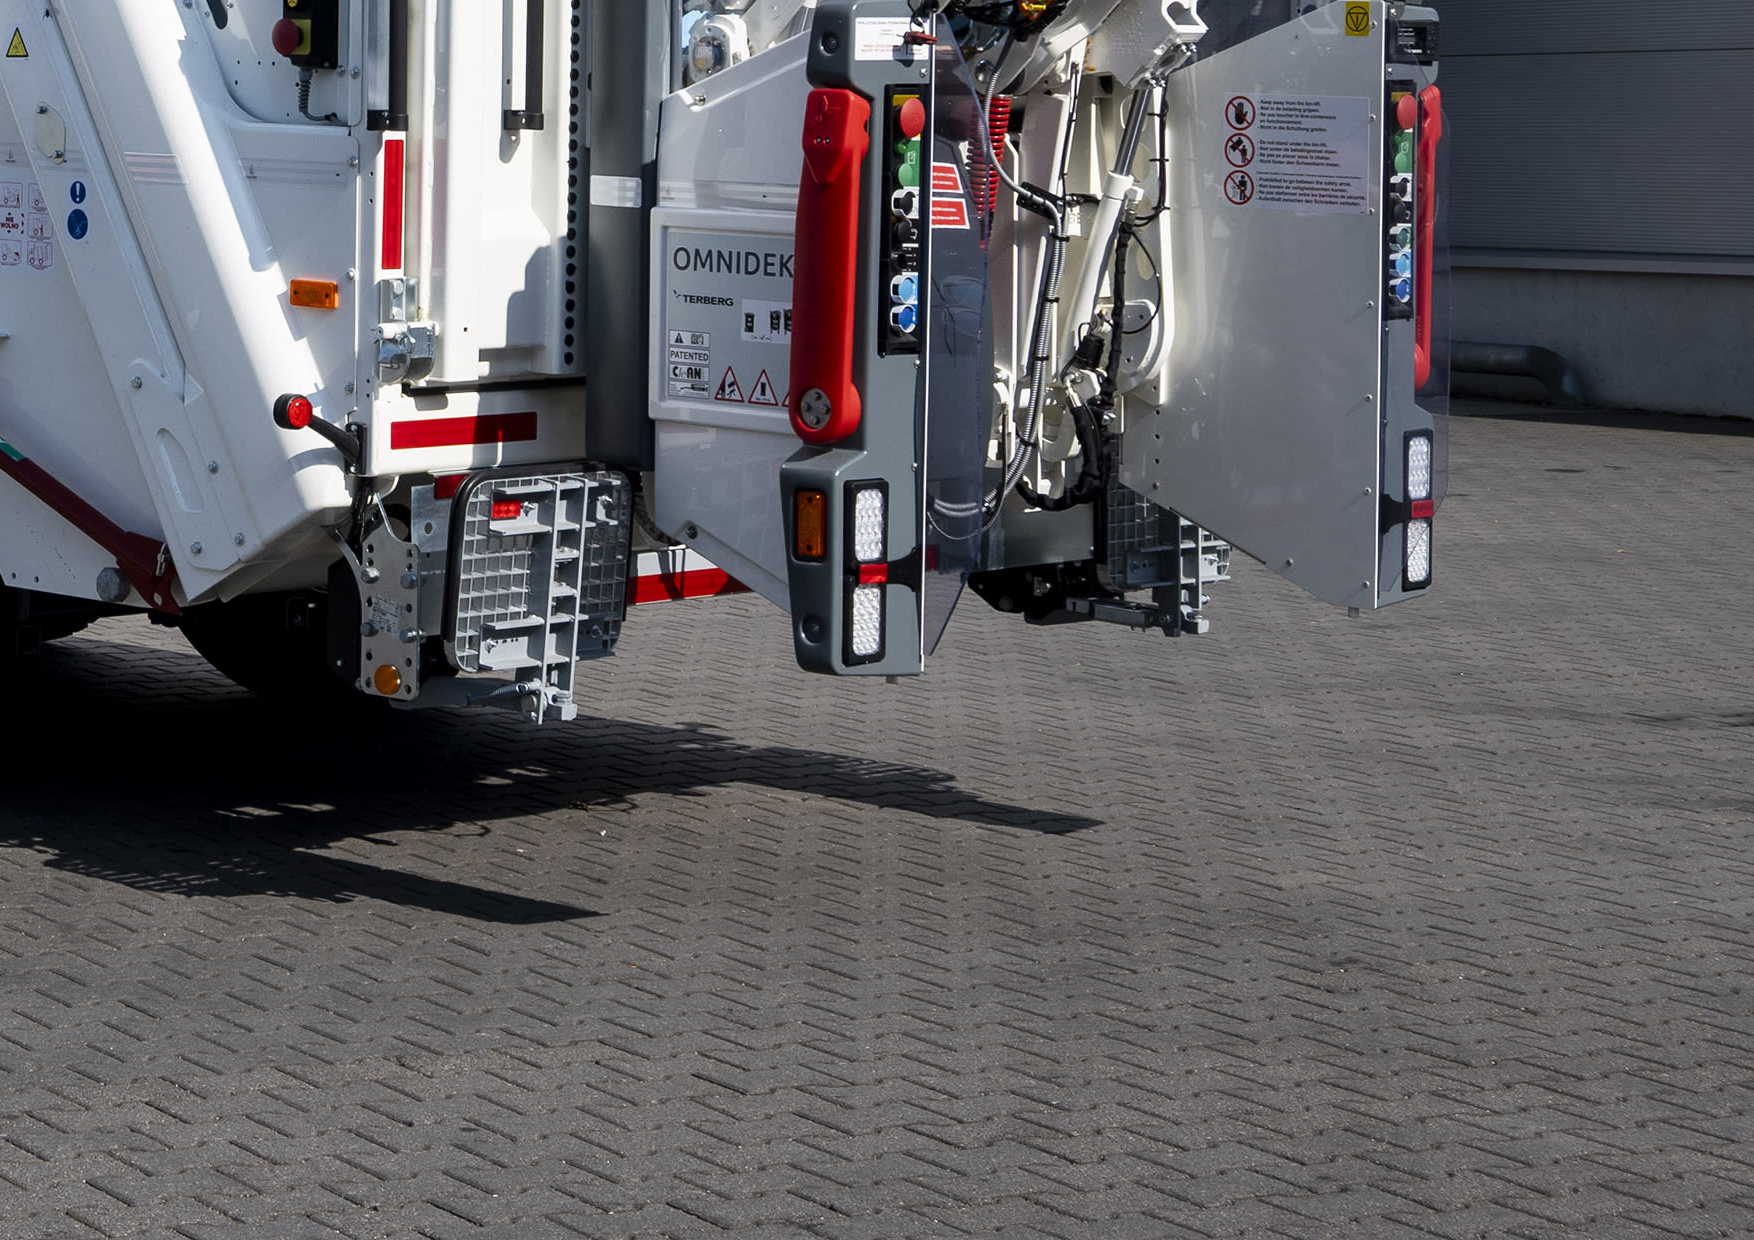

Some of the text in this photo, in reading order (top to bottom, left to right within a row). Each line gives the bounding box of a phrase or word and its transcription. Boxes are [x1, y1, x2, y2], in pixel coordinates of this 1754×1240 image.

[673, 247, 794, 278] OMNIDEK
[683, 294, 734, 306] TERBERG
[670, 350, 709, 362] PATENTED
